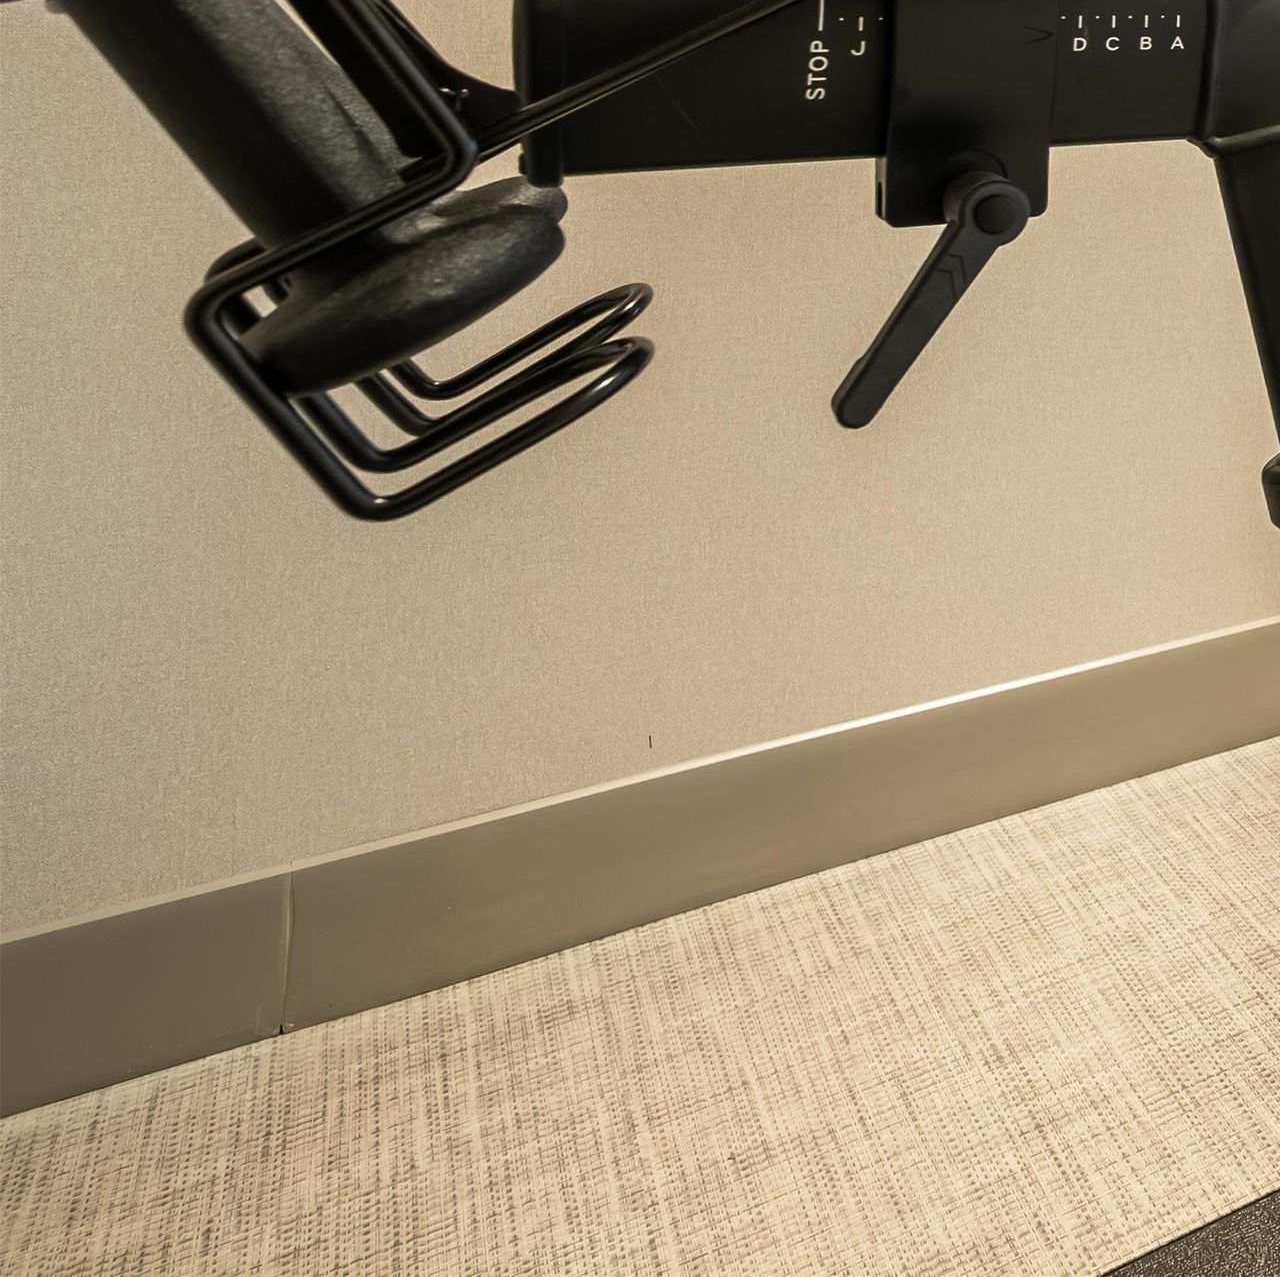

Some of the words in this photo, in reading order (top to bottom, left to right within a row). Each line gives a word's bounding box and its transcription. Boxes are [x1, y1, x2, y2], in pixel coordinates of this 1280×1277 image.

[850, 40, 866, 56] J
[1073, 37, 1087, 51] D
[1105, 37, 1120, 51] C
[1139, 36, 1152, 50] B
[1170, 36, 1185, 50] A
[805, 40, 829, 100] STOP
